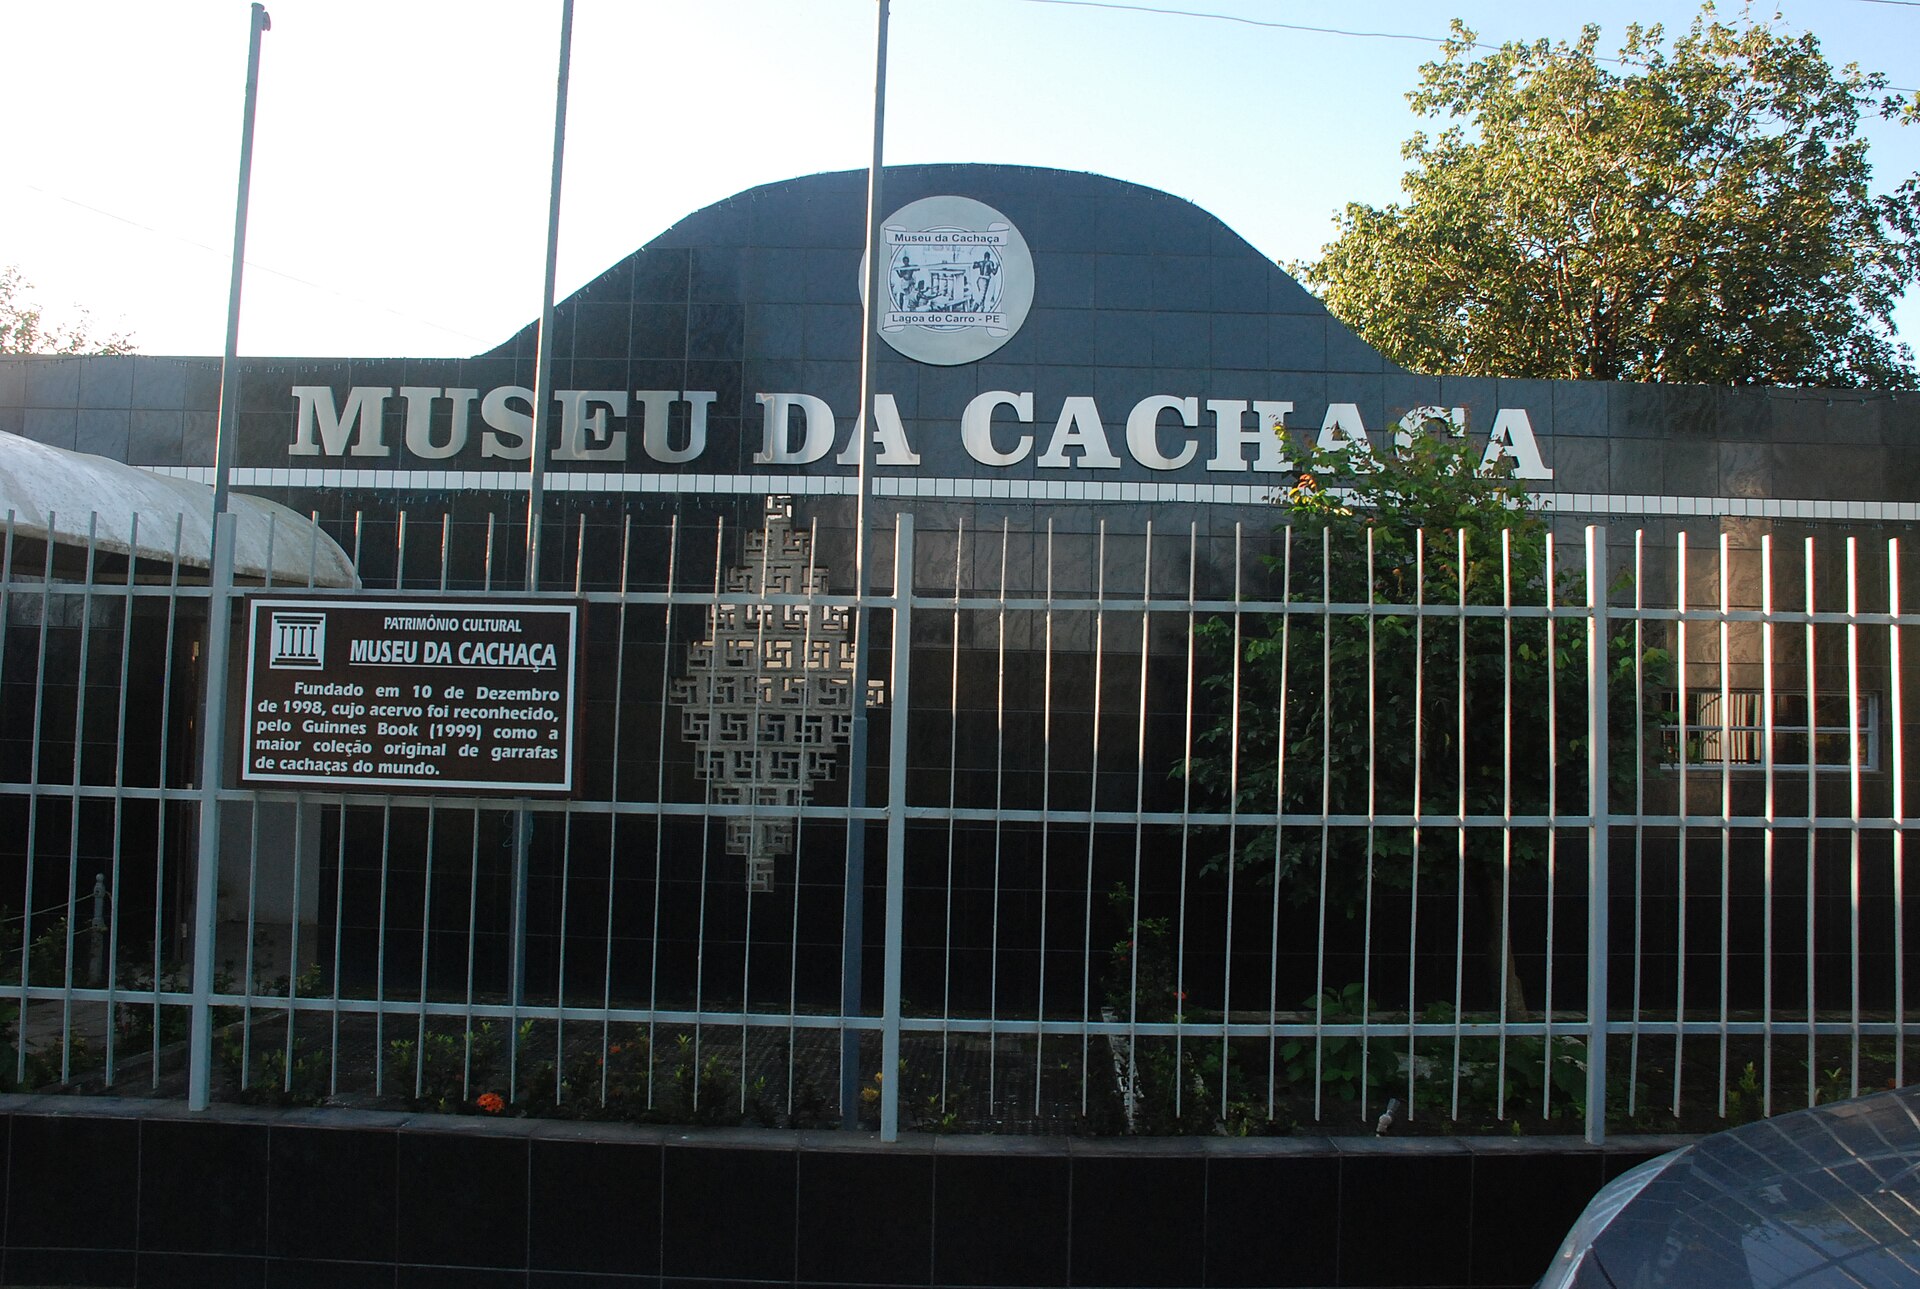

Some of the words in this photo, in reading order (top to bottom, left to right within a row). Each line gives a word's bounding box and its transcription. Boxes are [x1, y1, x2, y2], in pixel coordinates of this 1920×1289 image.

[894, 233, 931, 243] Museu
[935, 233, 949, 243] da
[951, 233, 1000, 244] Cachaça
[892, 314, 925, 324] Lagoa
[928, 314, 942, 323] do
[945, 314, 975, 323] Carro
[985, 314, 1000, 324] PE
[288, 386, 717, 464] MUSEU
[753, 393, 921, 466] DA
[384, 614, 459, 631] PATRIMÔNIO
[462, 618, 522, 632] CULTURAL
[350, 640, 418, 663] MUSEU
[423, 641, 453, 664] DA
[458, 641, 557, 672] CACHAÇA
[294, 682, 364, 696] Fundado
[375, 686, 399, 697] em
[413, 685, 432, 698] 10
[443, 686, 464, 699] de
[476, 686, 560, 701] Dezembro
[257, 700, 277, 713] de
[283, 700, 327, 716] 1998,
[331, 703, 365, 718] cujo
[369, 705, 422, 717] acervo
[427, 704, 449, 718] foi
[453, 706, 559, 723] reconhecido,
[256, 719, 291, 734] pelo
[302, 720, 367, 735] Guinnes
[377, 722, 418, 736] Book
[429, 723, 482, 741] (1999)
[493, 728, 538, 740] como
[548, 729, 559, 740] a
[256, 738, 302, 751] maior
[313, 739, 372, 757] coleção
[384, 742, 447, 759] original
[458, 744, 479, 757] de
[491, 746, 558, 761] garrafas
[255, 756, 275, 769] de
[279, 757, 348, 775] cachaças
[352, 760, 373, 773] do
[378, 762, 440, 775] mundo.
